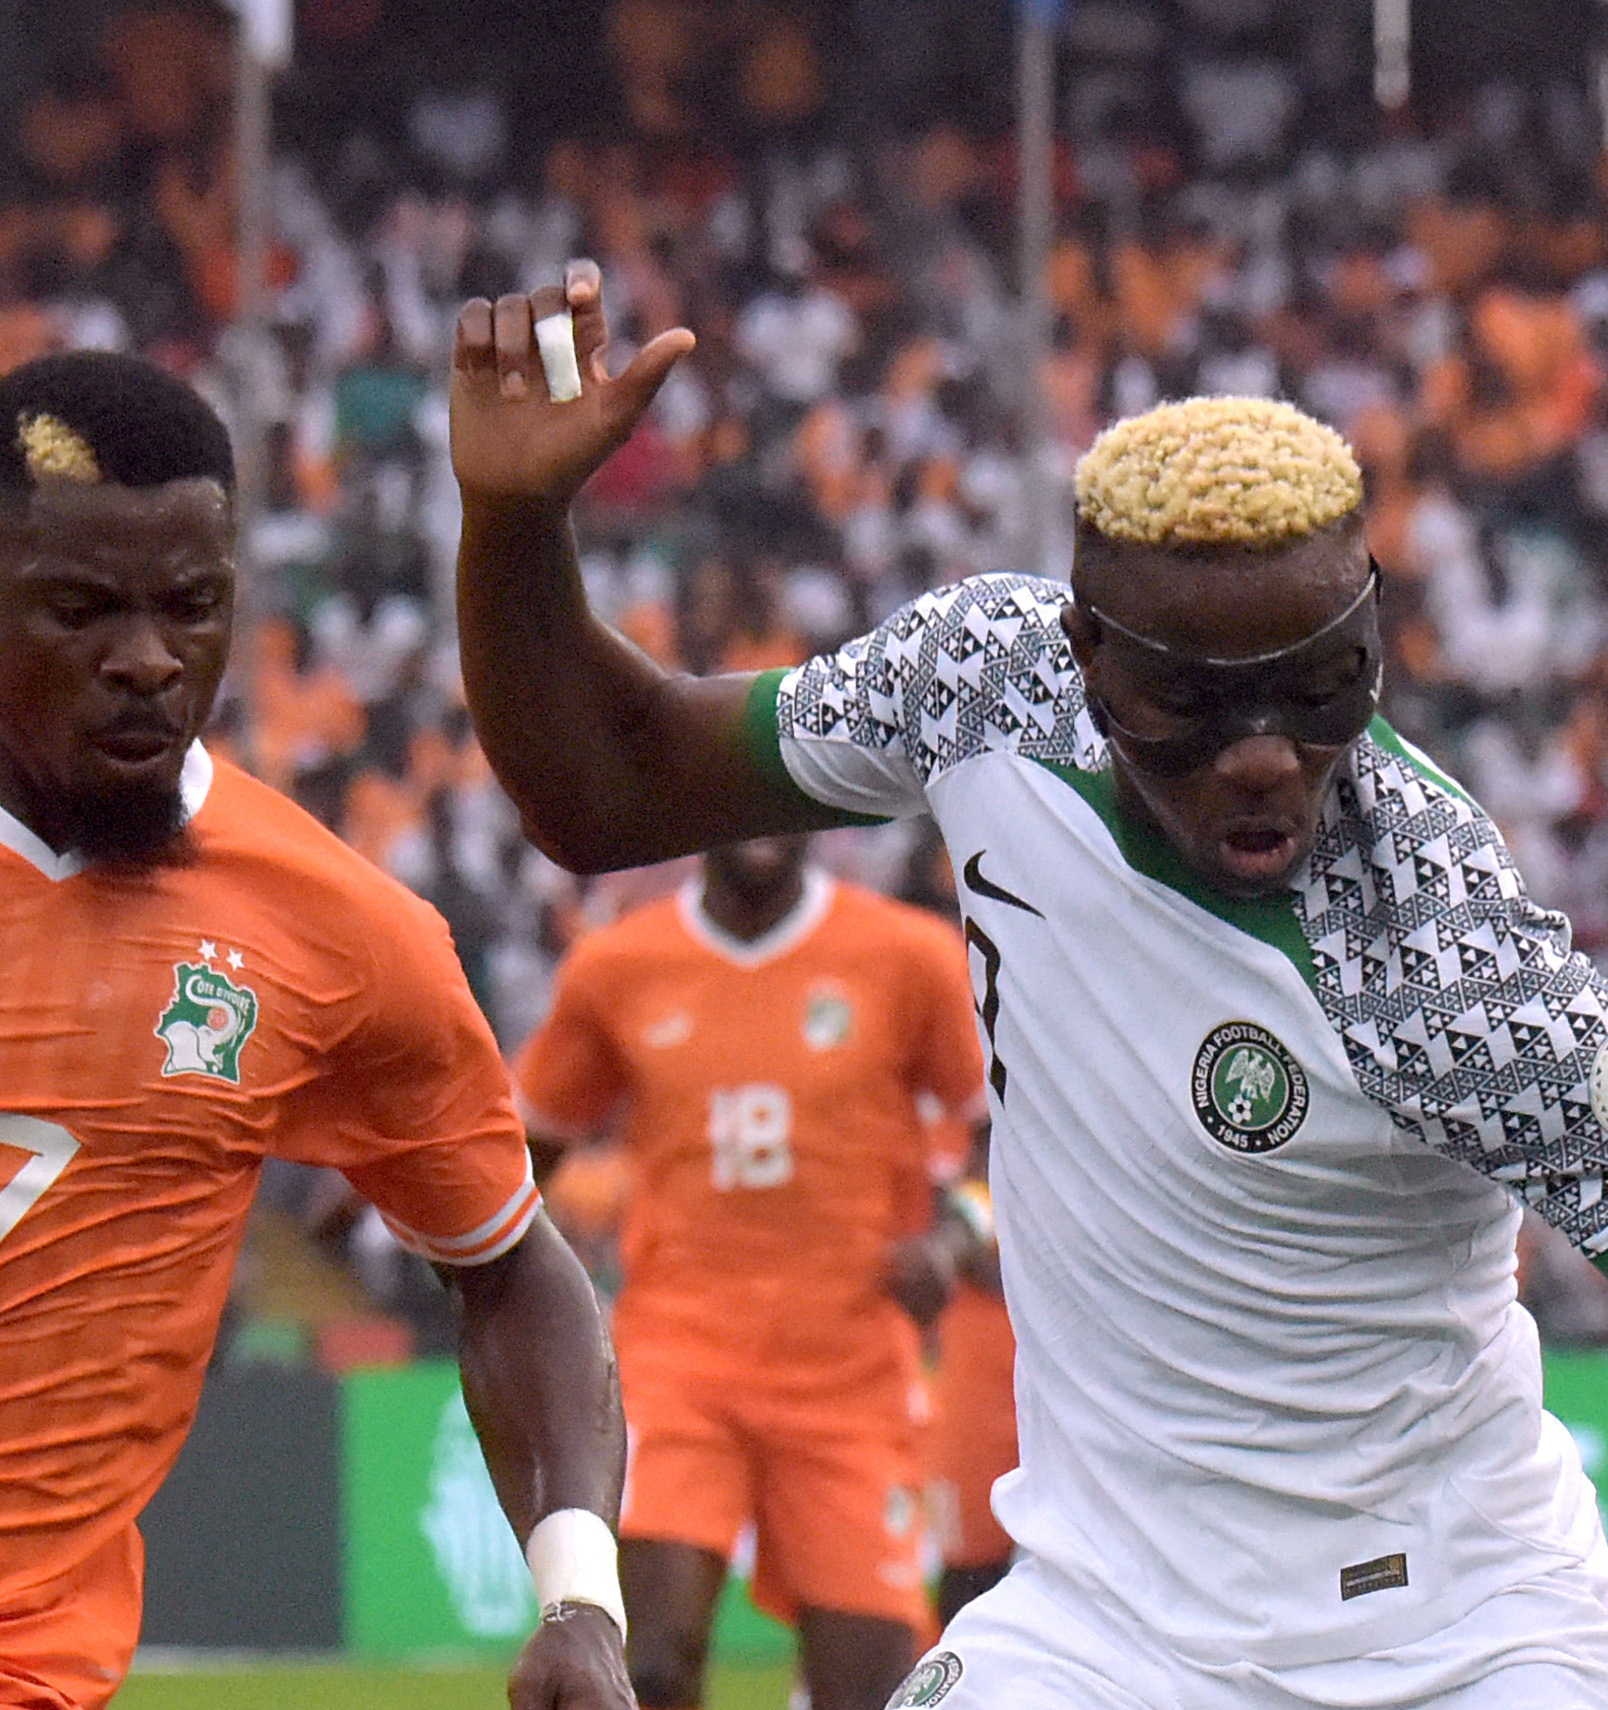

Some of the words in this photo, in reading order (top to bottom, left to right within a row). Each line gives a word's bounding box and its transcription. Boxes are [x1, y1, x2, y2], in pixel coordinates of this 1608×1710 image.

[710, 1085, 793, 1191] 18
[1195, 1042, 1218, 1108] NIGERIA
[1213, 1026, 1283, 1056] FOOTBALL
[1267, 1055, 1307, 1145] FEDERATION
[1217, 1125, 1249, 1148] 1945
